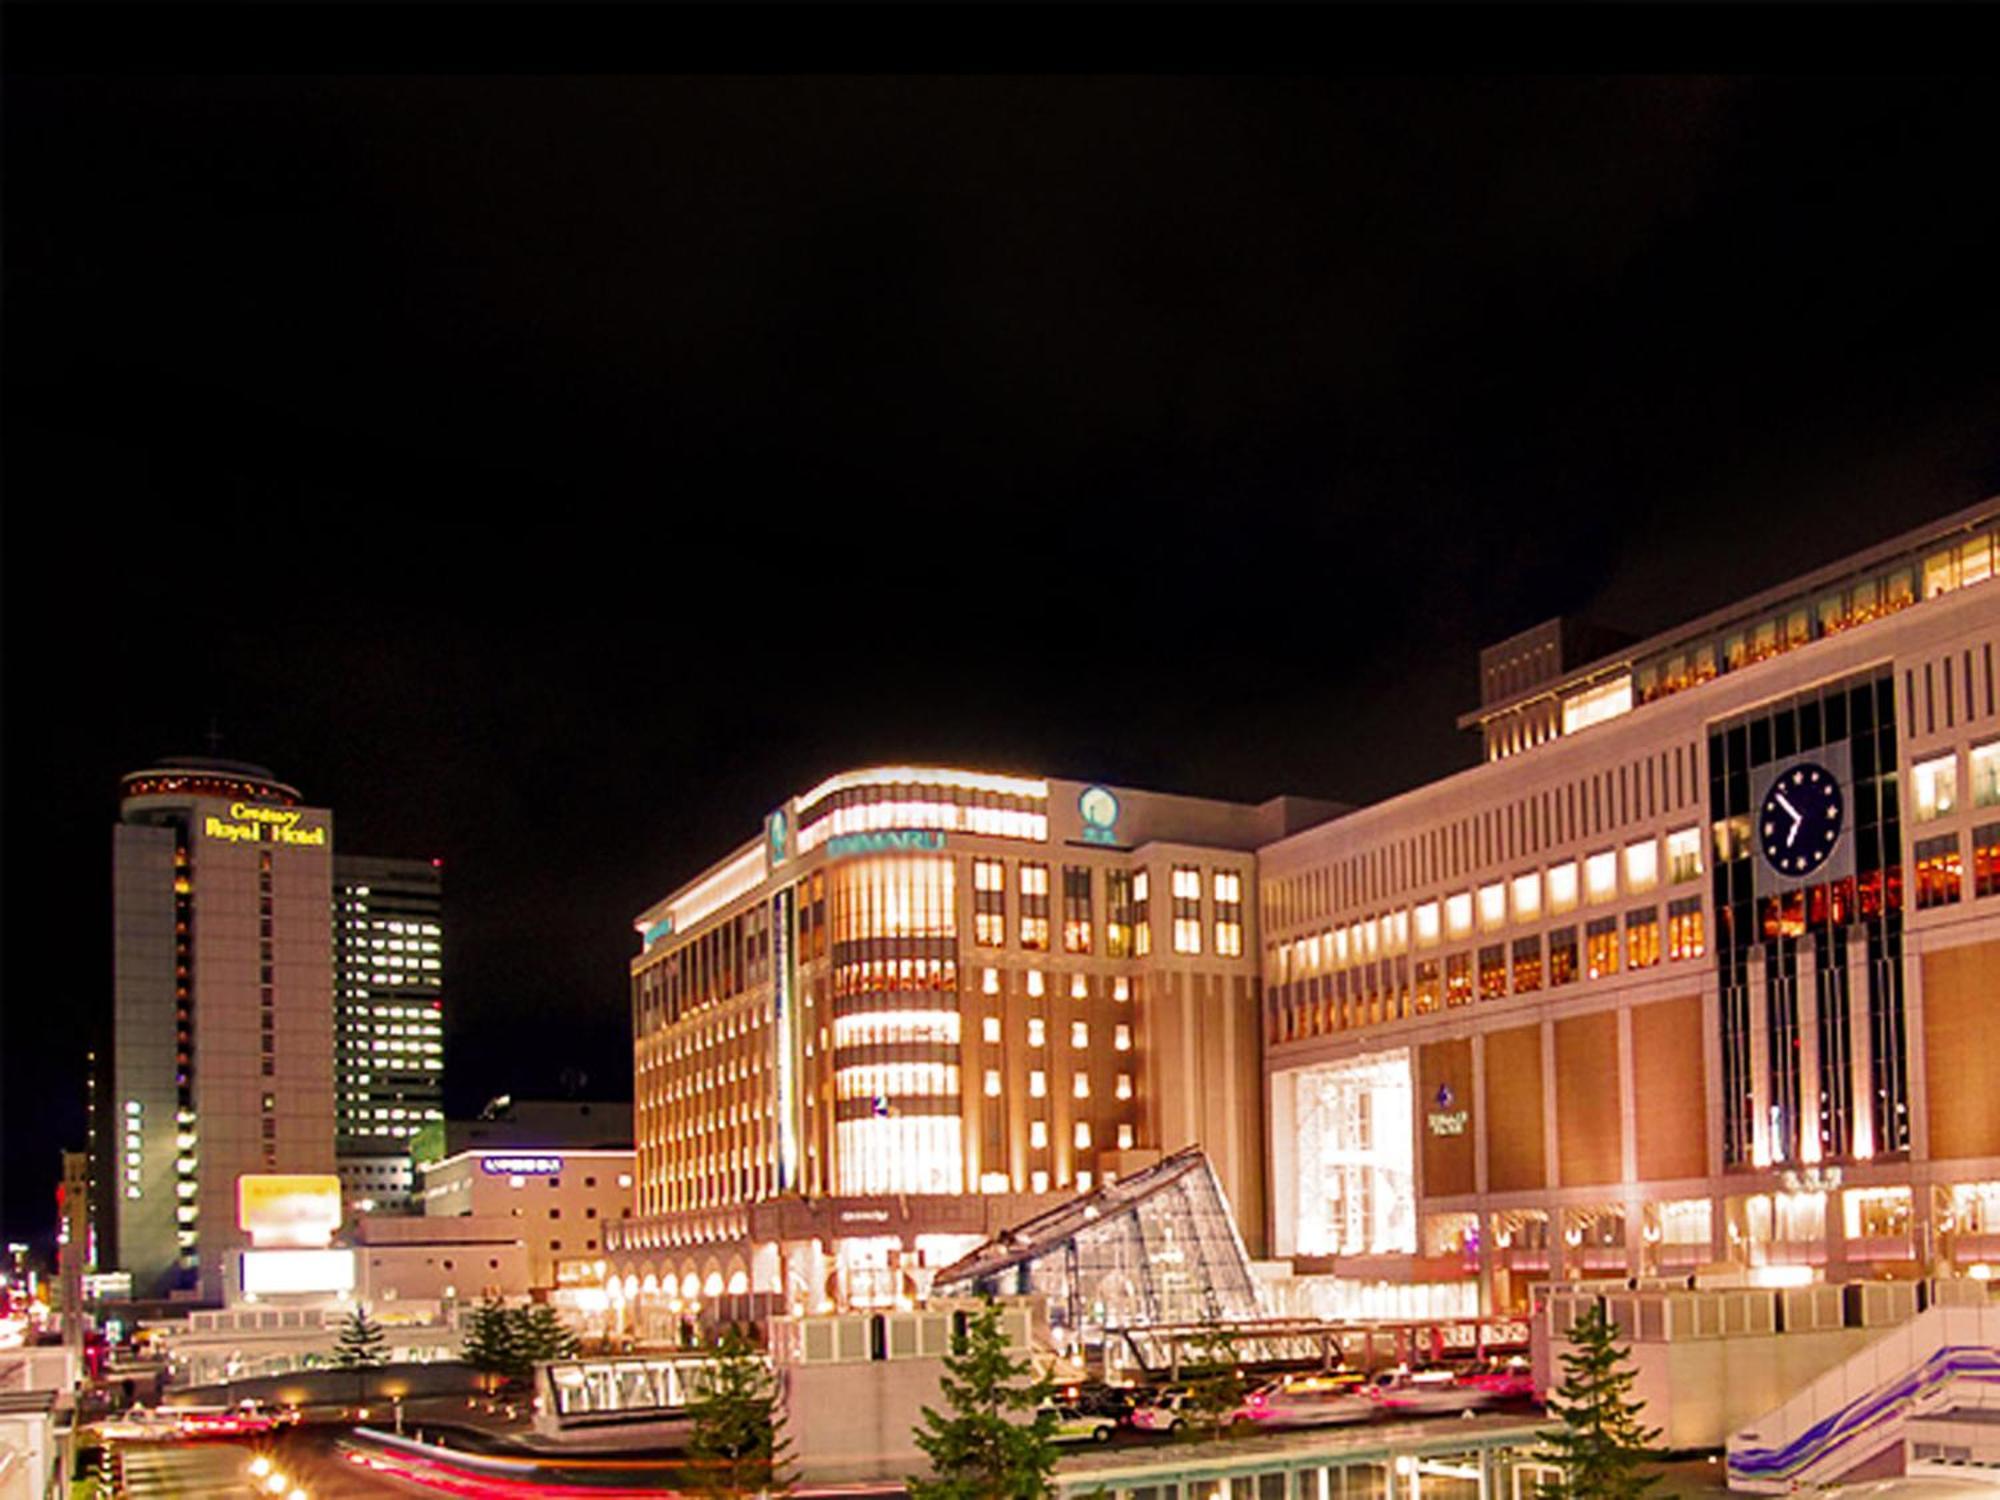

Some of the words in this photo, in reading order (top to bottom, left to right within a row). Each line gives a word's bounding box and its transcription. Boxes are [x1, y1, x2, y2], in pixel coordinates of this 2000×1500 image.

[206, 816, 260, 842] Royal
[272, 824, 324, 845] Hotel
[826, 831, 945, 857] DMARU
